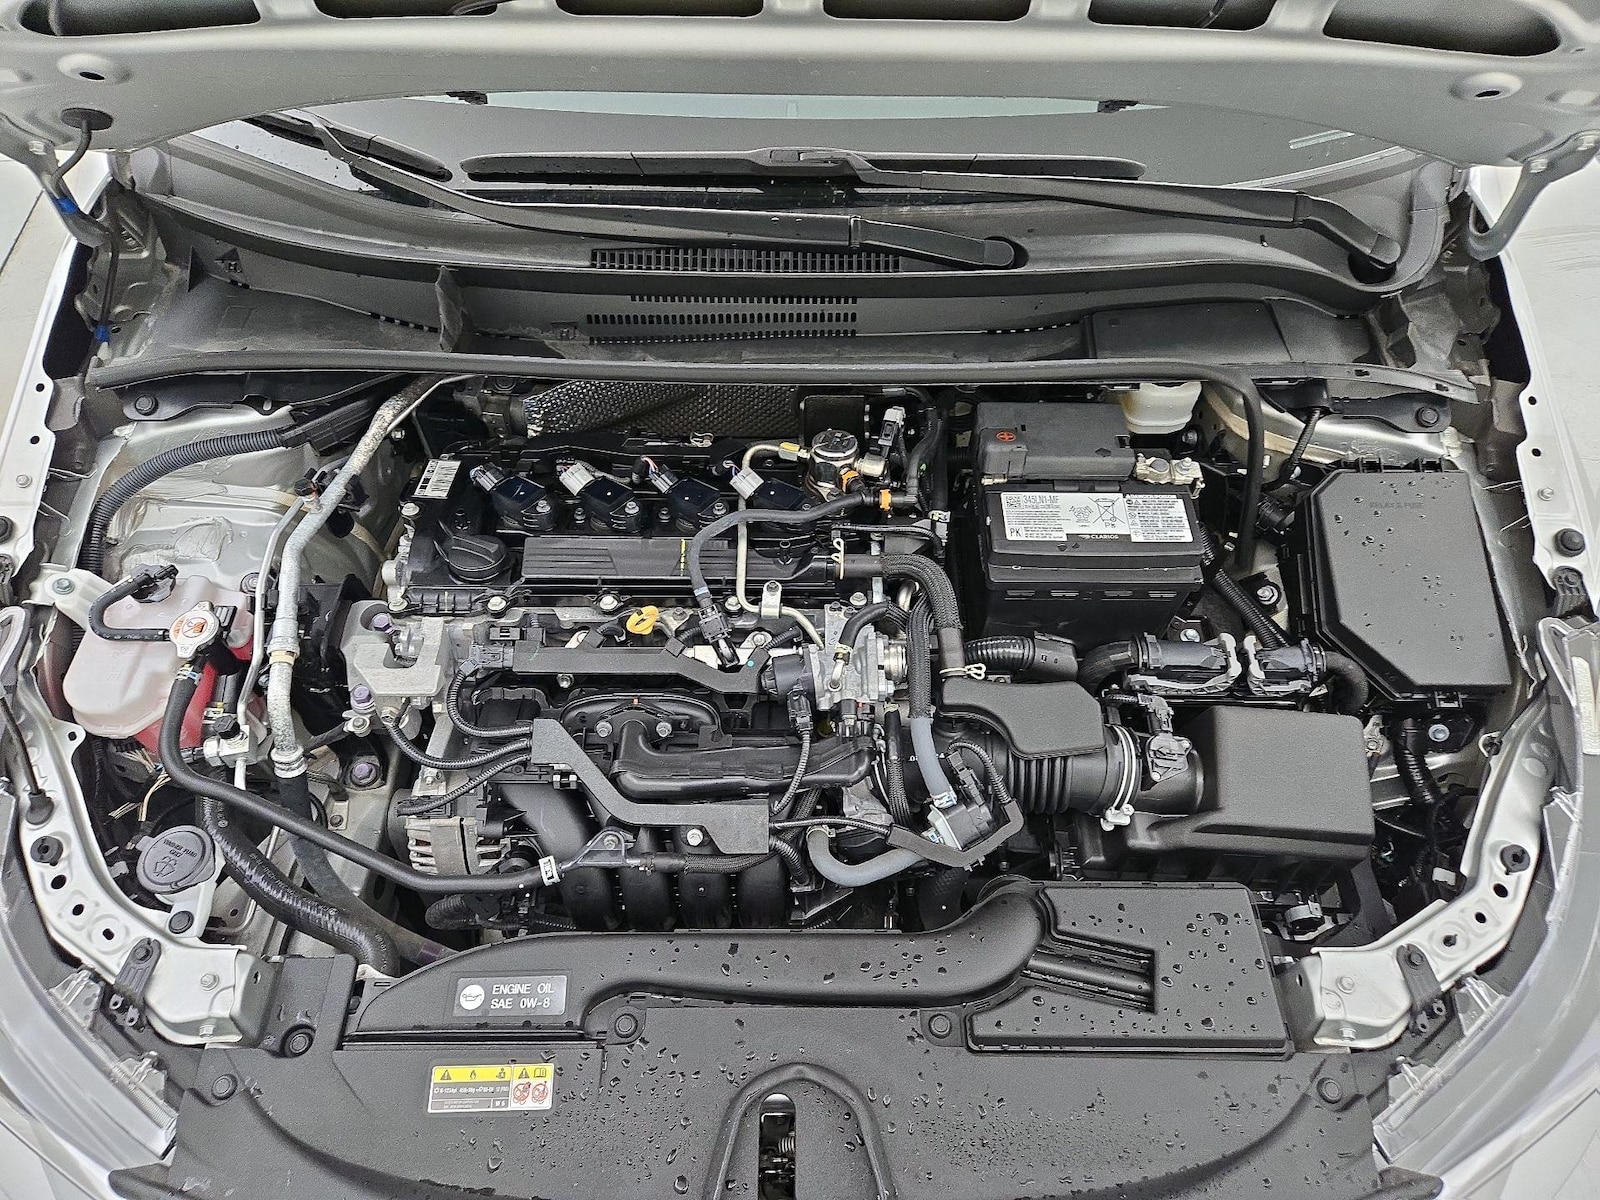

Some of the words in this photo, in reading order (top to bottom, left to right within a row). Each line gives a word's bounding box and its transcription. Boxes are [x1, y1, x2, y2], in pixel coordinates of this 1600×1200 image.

[1009, 527, 1021, 537] PK
[492, 984, 532, 995] ENGINE
[537, 982, 555, 993] OIL
[490, 998, 513, 1009] SAE
[520, 997, 551, 1009] 0W-8
